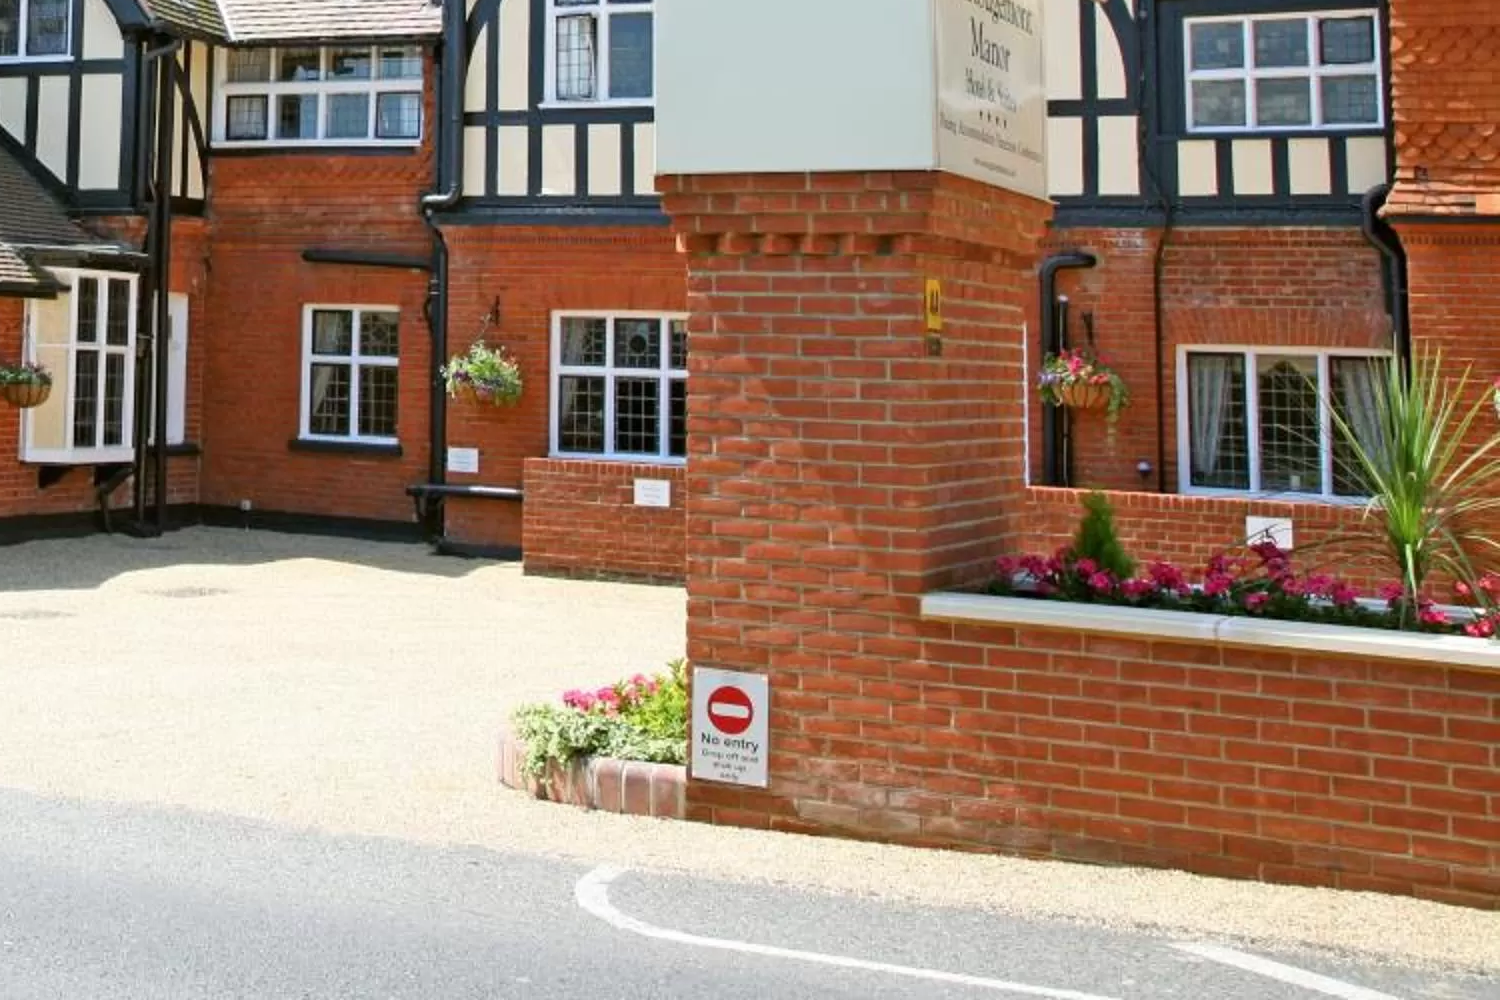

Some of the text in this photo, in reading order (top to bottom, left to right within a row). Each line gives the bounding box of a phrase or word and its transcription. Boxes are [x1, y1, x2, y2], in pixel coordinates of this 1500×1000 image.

[970, 16, 1011, 72] Manor
[701, 731, 759, 754] No entry
